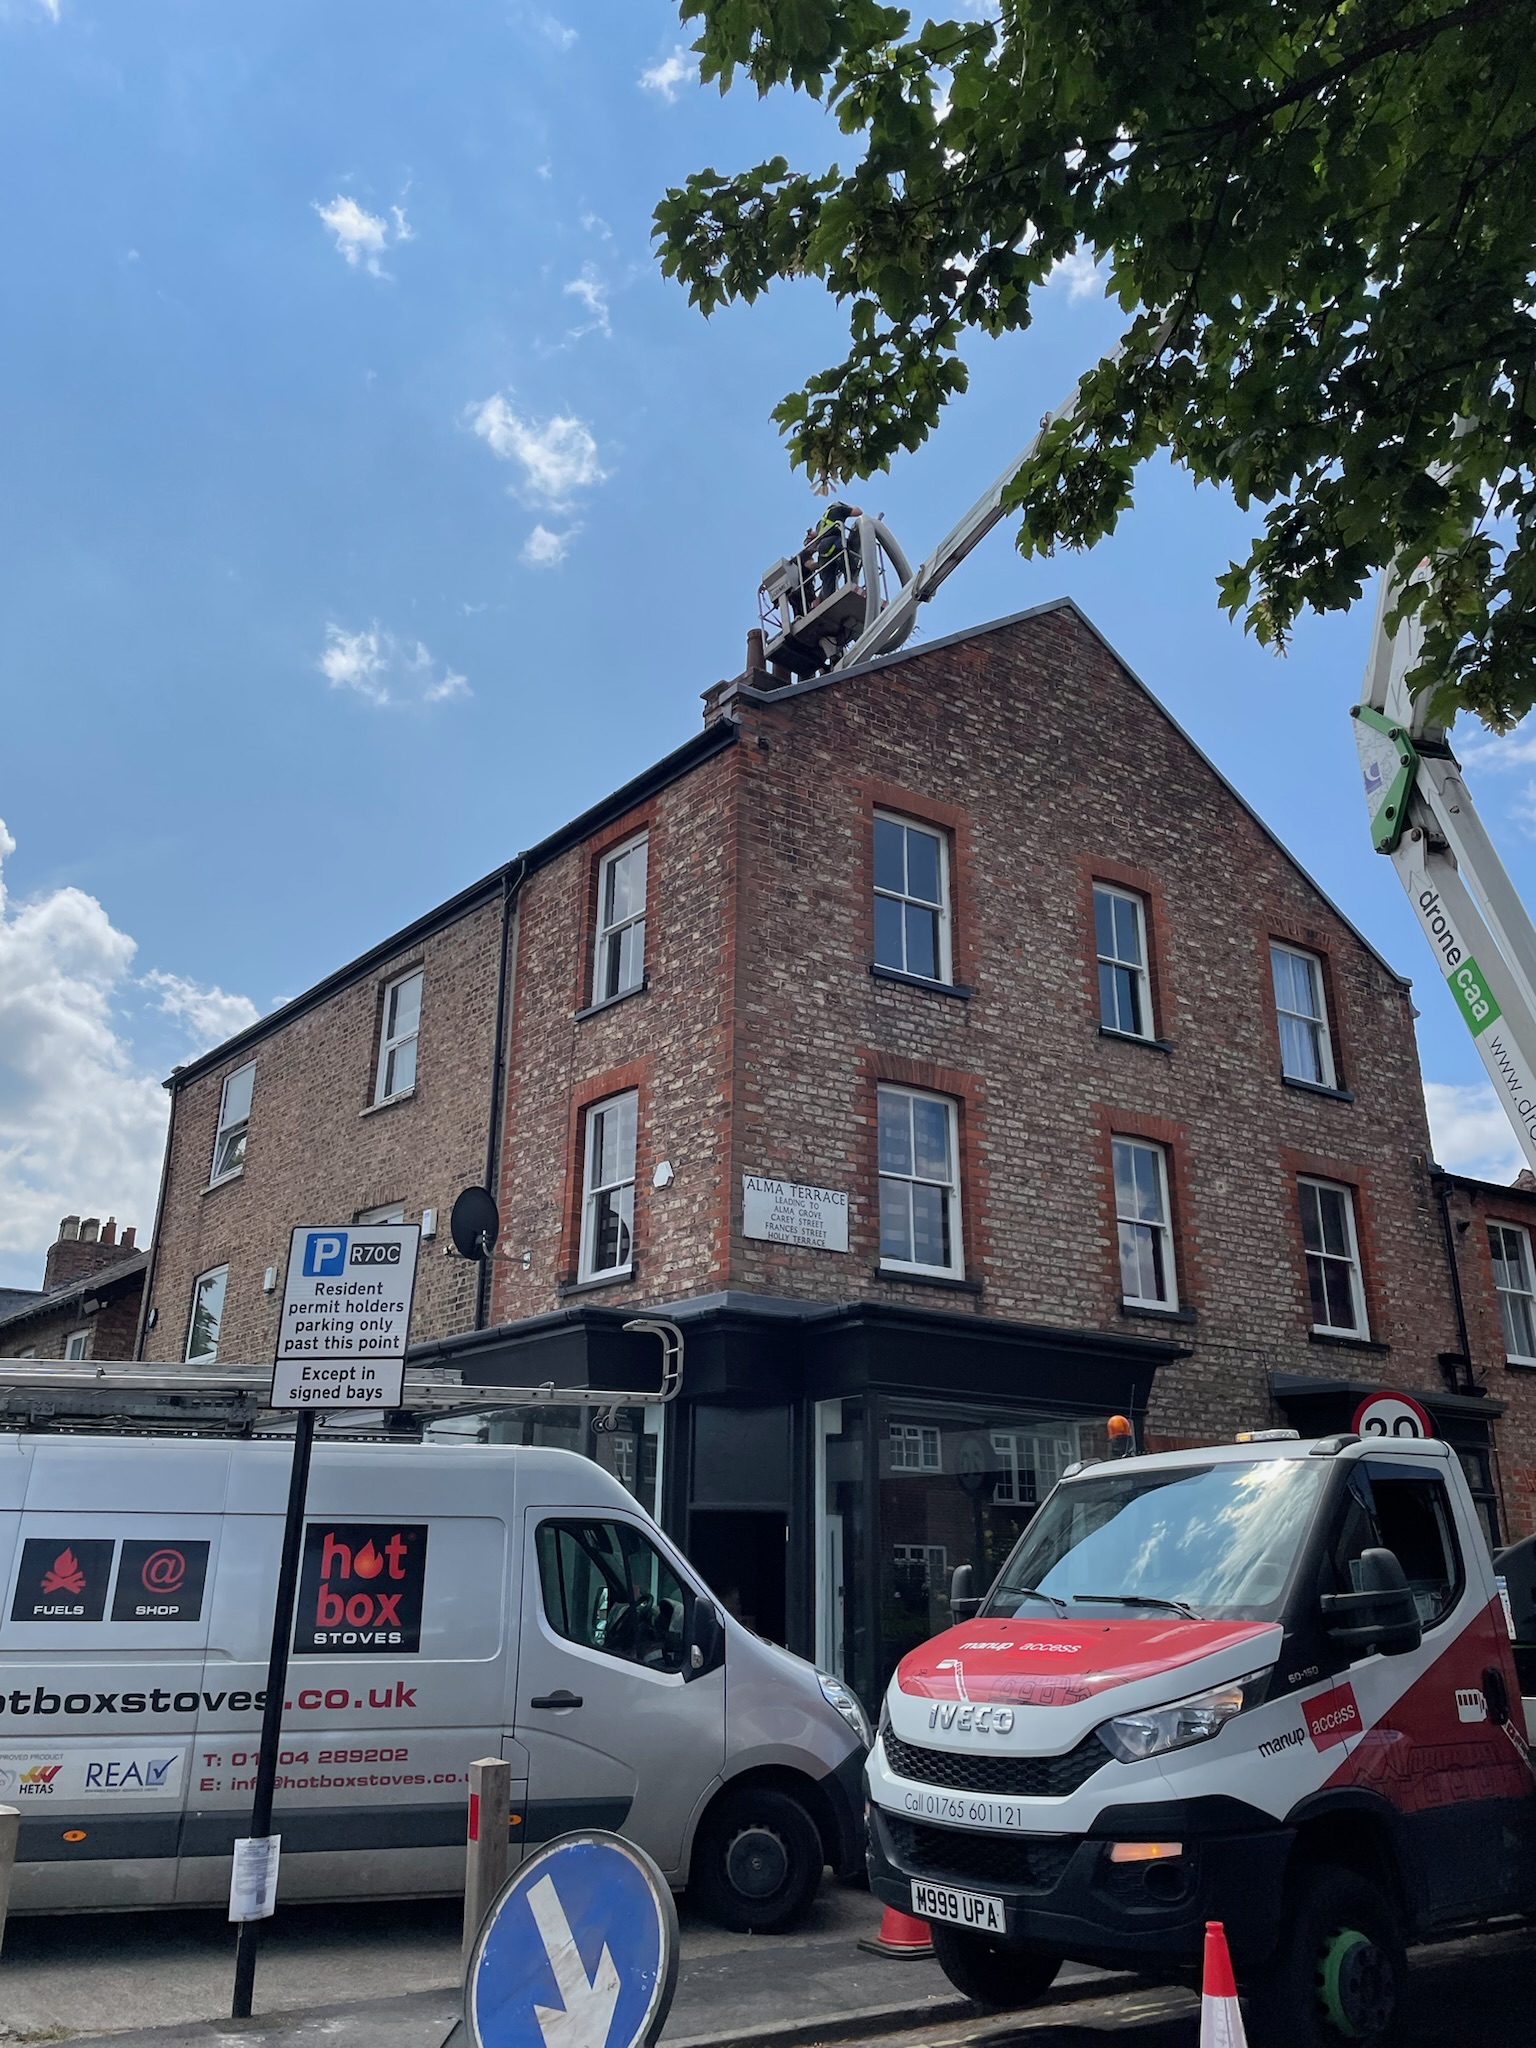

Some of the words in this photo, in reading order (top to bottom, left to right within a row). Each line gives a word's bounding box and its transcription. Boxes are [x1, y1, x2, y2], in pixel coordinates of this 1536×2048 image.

[1419, 890, 1462, 966] drone
[1457, 968, 1490, 1022] caa
[747, 1178, 784, 1195] ALMA
[790, 1185, 846, 1206] TERRACE
[775, 1196, 805, 1208] LEADING
[809, 1201, 820, 1210] TO
[774, 1205, 795, 1215] ALMA
[798, 1209, 822, 1219] GROVE
[770, 1213, 795, 1224] CAREY
[798, 1218, 824, 1229] STREET
[765, 1222, 798, 1234] FRANCES
[801, 1227, 827, 1239] STREET
[767, 1231, 790, 1241] HOLLY
[792, 1235, 826, 1247] TERRACE
[313, 1237, 340, 1273] P
[351, 1245, 400, 1263] R70C
[315, 1281, 383, 1296] Resident
[289, 1300, 340, 1316] permit
[346, 1300, 404, 1314] holders
[295, 1318, 354, 1334] parking
[360, 1317, 393, 1332] only
[284, 1336, 318, 1352] past
[325, 1335, 353, 1350] this
[358, 1335, 400, 1351] point
[302, 1366, 356, 1383] Except
[362, 1366, 375, 1381] in
[289, 1385, 340, 1402] signed
[346, 1385, 383, 1401] bays
[1365, 1415, 1419, 1438] 20
[33, 1605, 85, 1615] FUELS
[135, 1605, 180, 1616] SHOP
[315, 1582, 403, 1628] box
[313, 1631, 402, 1645] STOVES
[958, 1642, 1015, 1651] manup
[1018, 1642, 1082, 1653] access
[0, 1681, 418, 1715] tboxstoves.co.uk
[928, 1704, 1015, 1735] IVECO
[1258, 1727, 1305, 1758] manup
[1311, 1704, 1356, 1735] access
[30, 1753, 65, 1761] PRODUCT
[203, 1754, 221, 1767] T:
[231, 1751, 309, 1767] 0104
[318, 1748, 408, 1764] 289202
[19, 1783, 54, 1795] HETAS
[200, 1778, 221, 1791] E:
[230, 1773, 469, 1791] inf@hotboxstoves.co.
[904, 1793, 924, 1812] Call
[926, 1796, 964, 1818] 01765
[969, 1802, 1022, 1826] 601121
[962, 1896, 998, 1928] UPA
